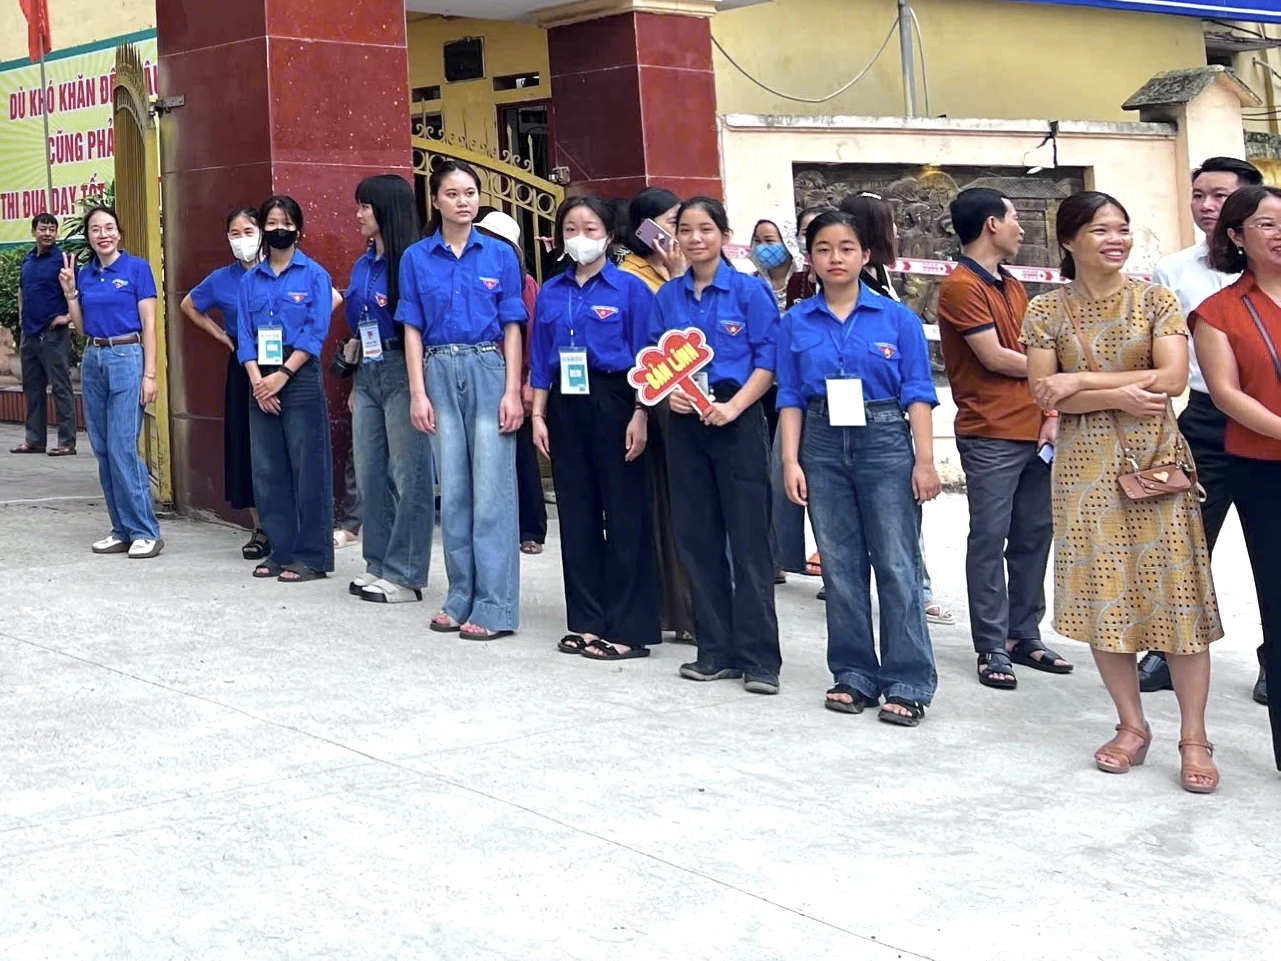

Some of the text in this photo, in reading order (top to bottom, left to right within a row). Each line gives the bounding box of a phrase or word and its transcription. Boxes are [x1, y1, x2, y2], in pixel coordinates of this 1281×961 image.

[10, 87, 25, 120] DÙ
[29, 81, 54, 117] KHÓ
[59, 75, 95, 113] KHĂN
[48, 131, 83, 165] CŨNG
[0, 192, 19, 220] THI
[22, 189, 48, 218] ĐUA
